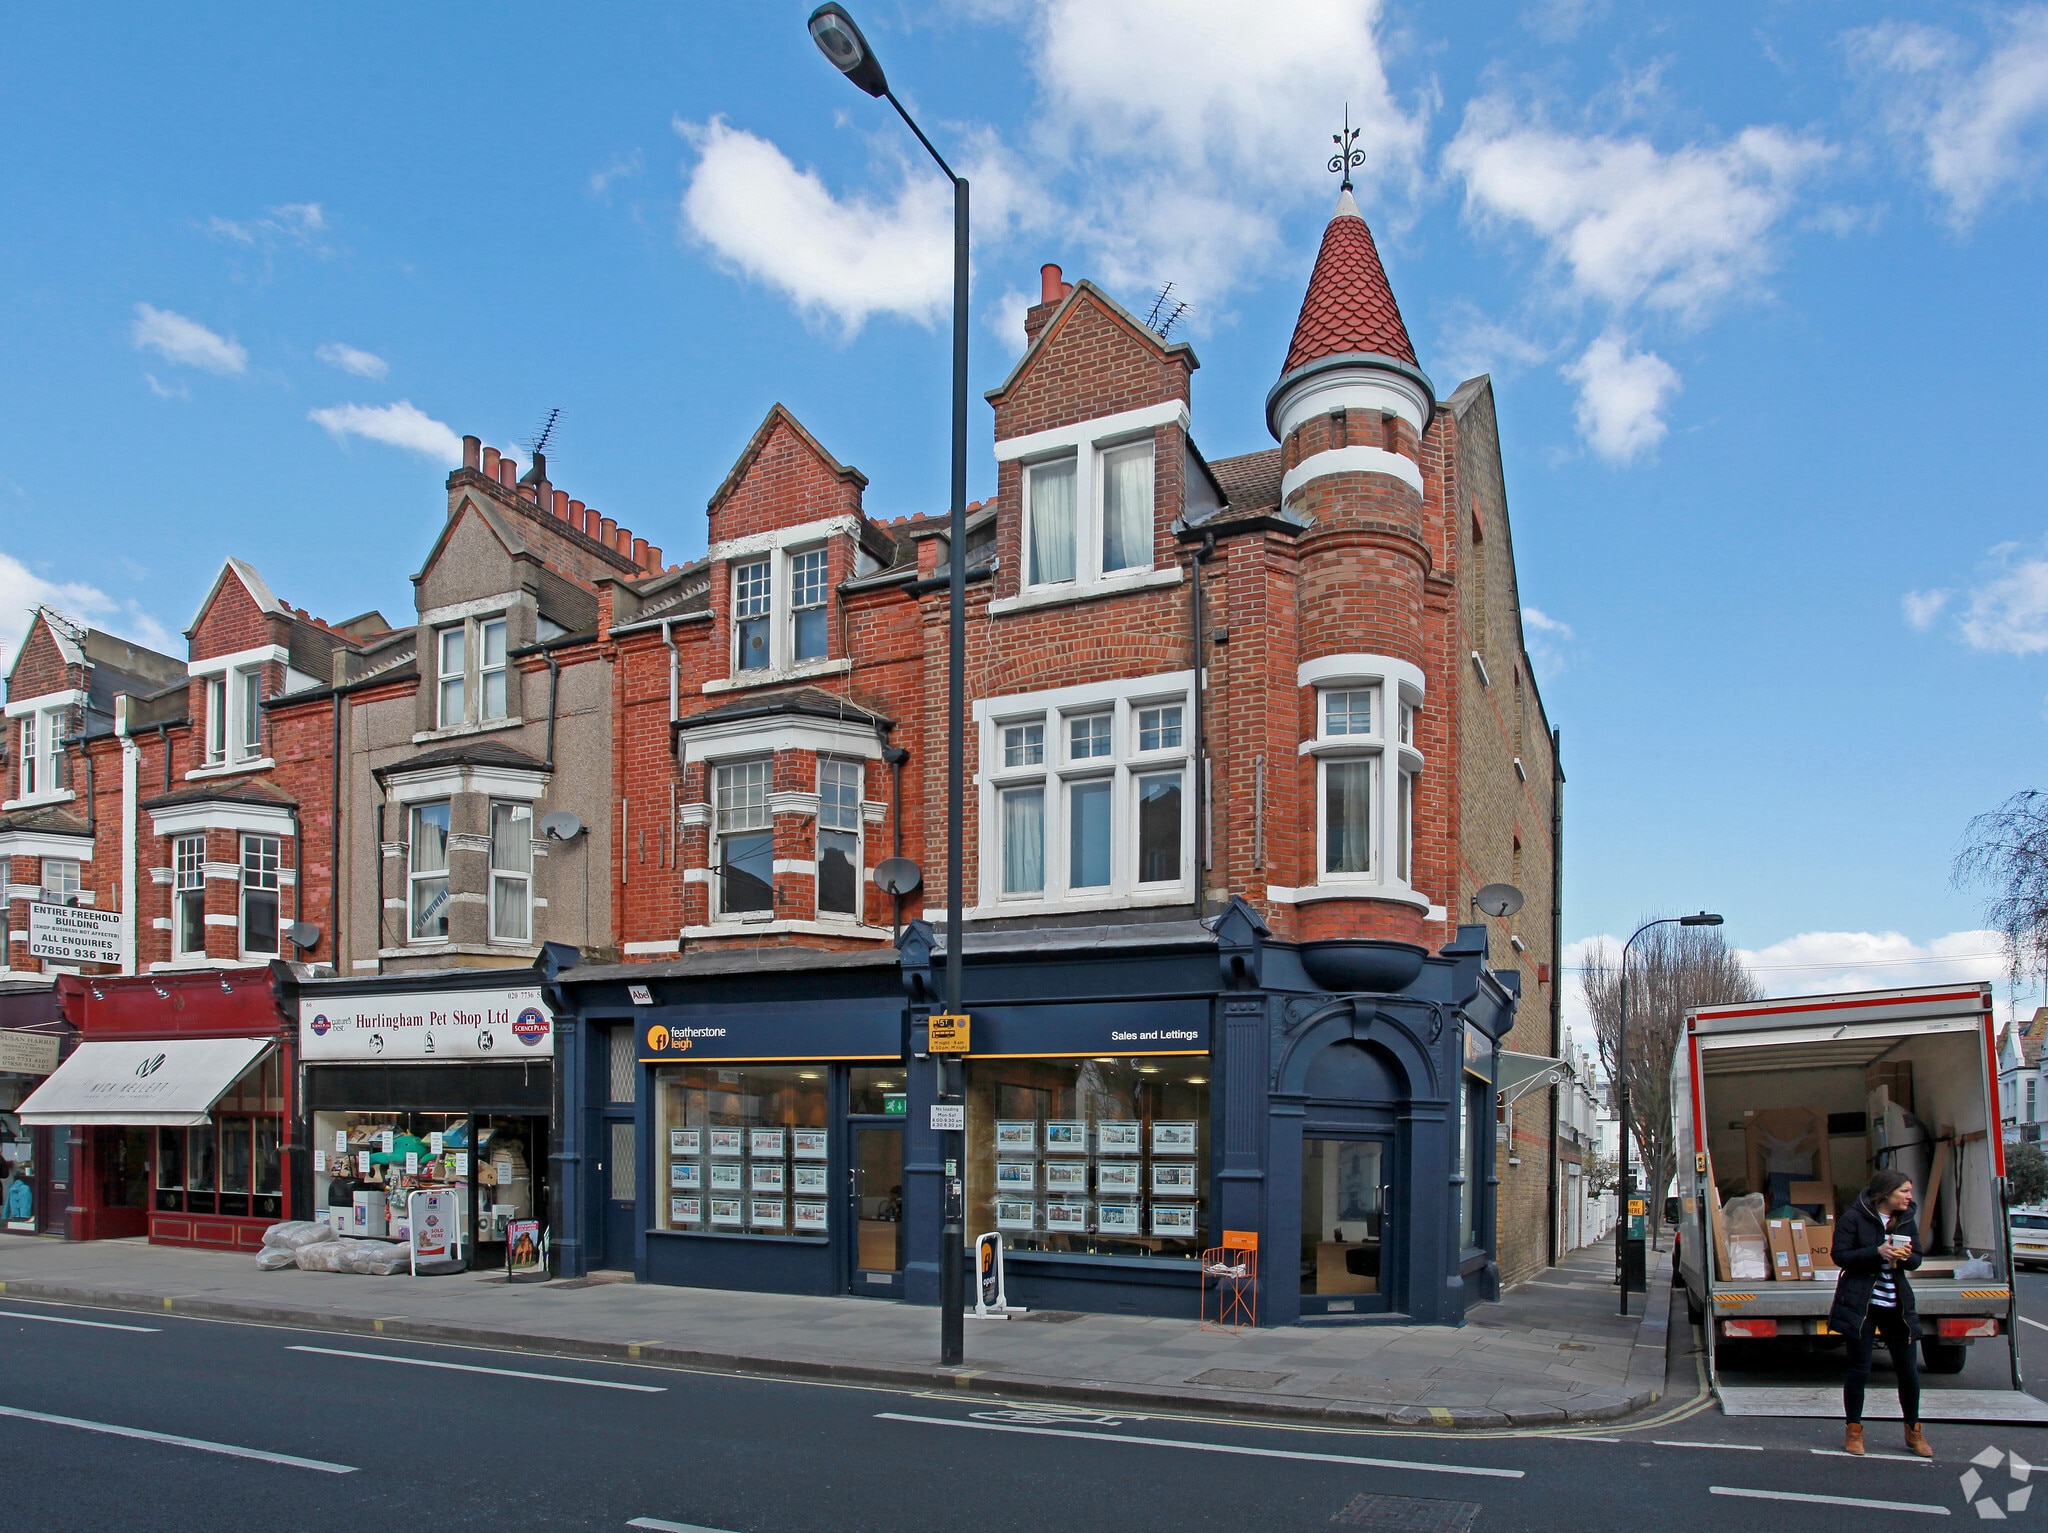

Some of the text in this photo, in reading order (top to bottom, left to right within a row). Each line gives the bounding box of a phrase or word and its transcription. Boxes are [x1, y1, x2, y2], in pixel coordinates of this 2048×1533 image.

[34, 905, 120, 923] ENTIRE FREEHOLD
[56, 917, 99, 930] BUILDING
[42, 934, 112, 948] ALL ENQUIRIES
[33, 944, 120, 961] 07850 936 187
[633, 990, 650, 999] Abel
[356, 1012, 423, 1031] Hurlingham
[430, 1011, 447, 1026] Pet
[453, 1010, 481, 1028] Shop
[488, 1009, 509, 1024] Ltd
[671, 1027, 726, 1038] featherstone
[1112, 1030, 1198, 1040] Sales and Lettings
[671, 1038, 692, 1051] leigh
[983, 1276, 995, 1286] open
